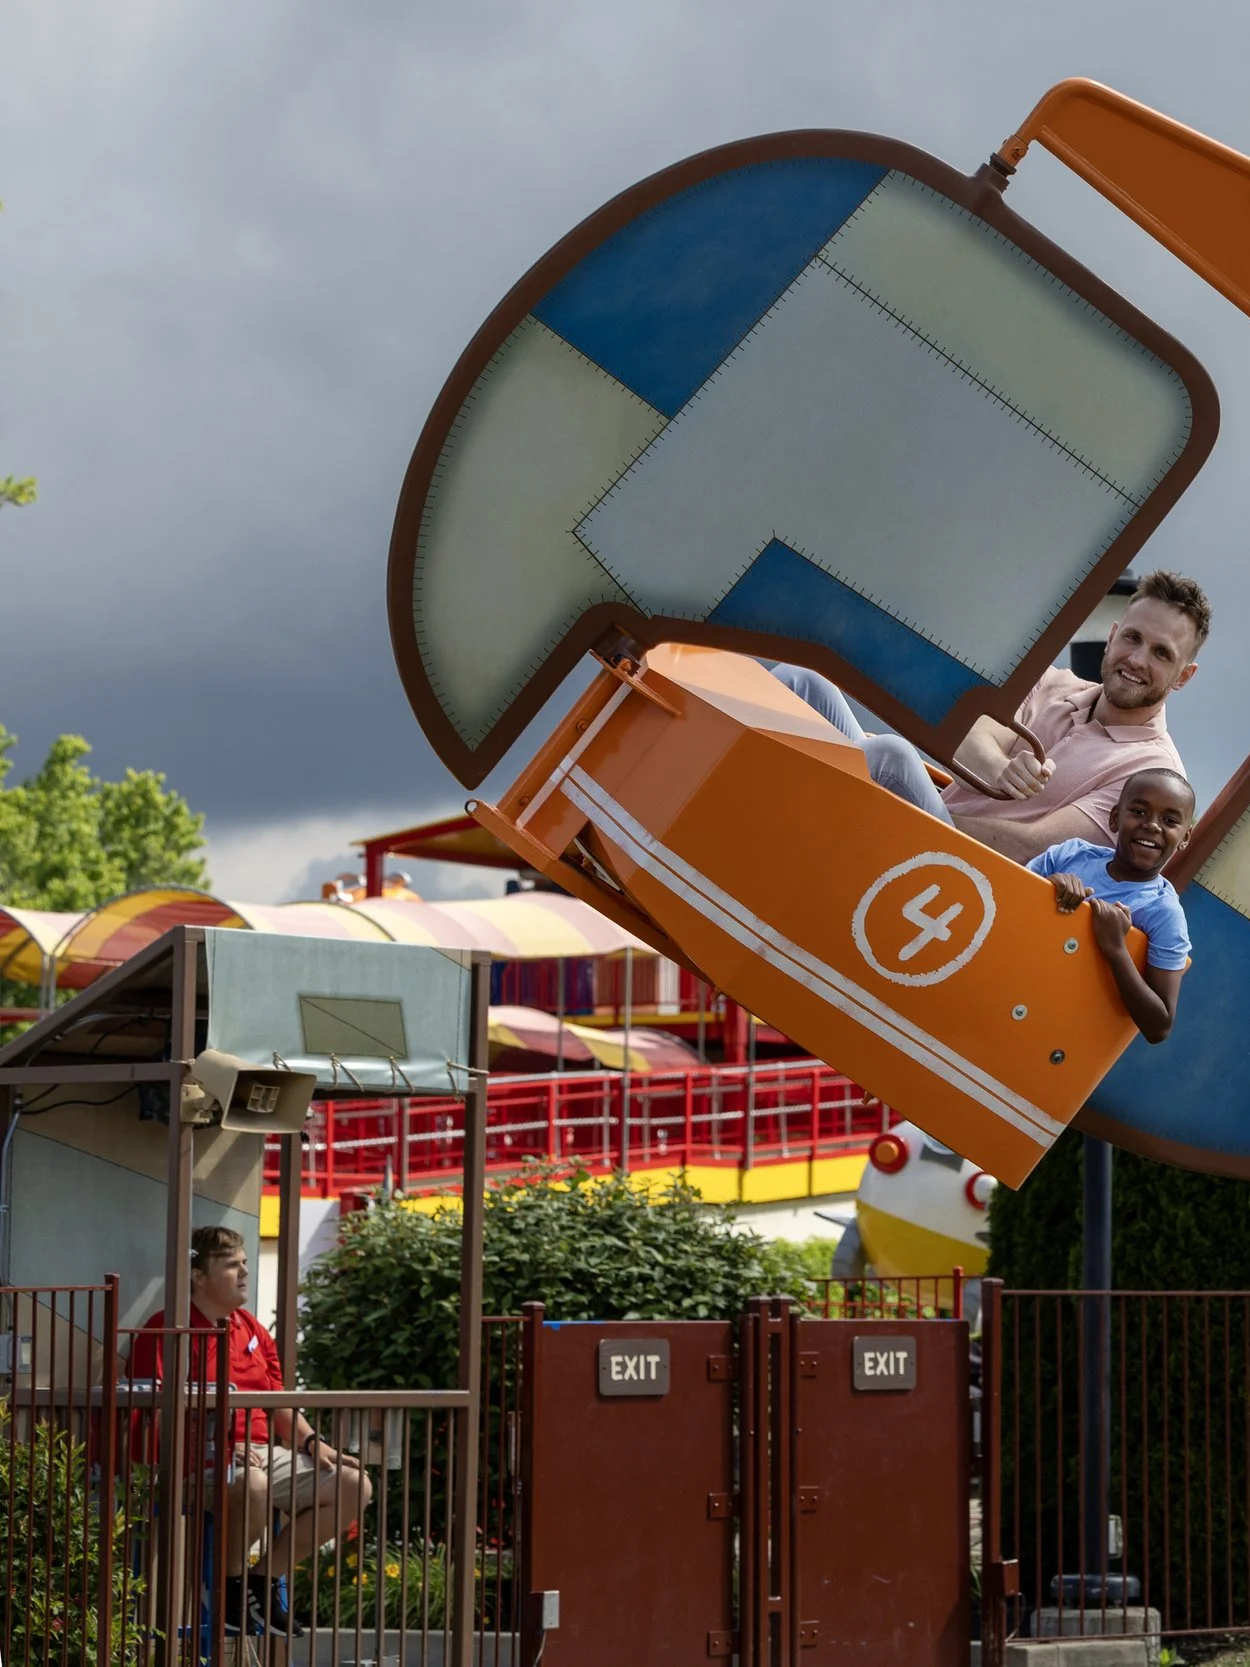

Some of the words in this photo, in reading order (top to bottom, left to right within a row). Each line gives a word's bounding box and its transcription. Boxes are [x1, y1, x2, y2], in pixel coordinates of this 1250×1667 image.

[898, 884, 964, 961] 4
[610, 1354, 661, 1381] EXIT
[863, 1351, 909, 1376] EXIT
